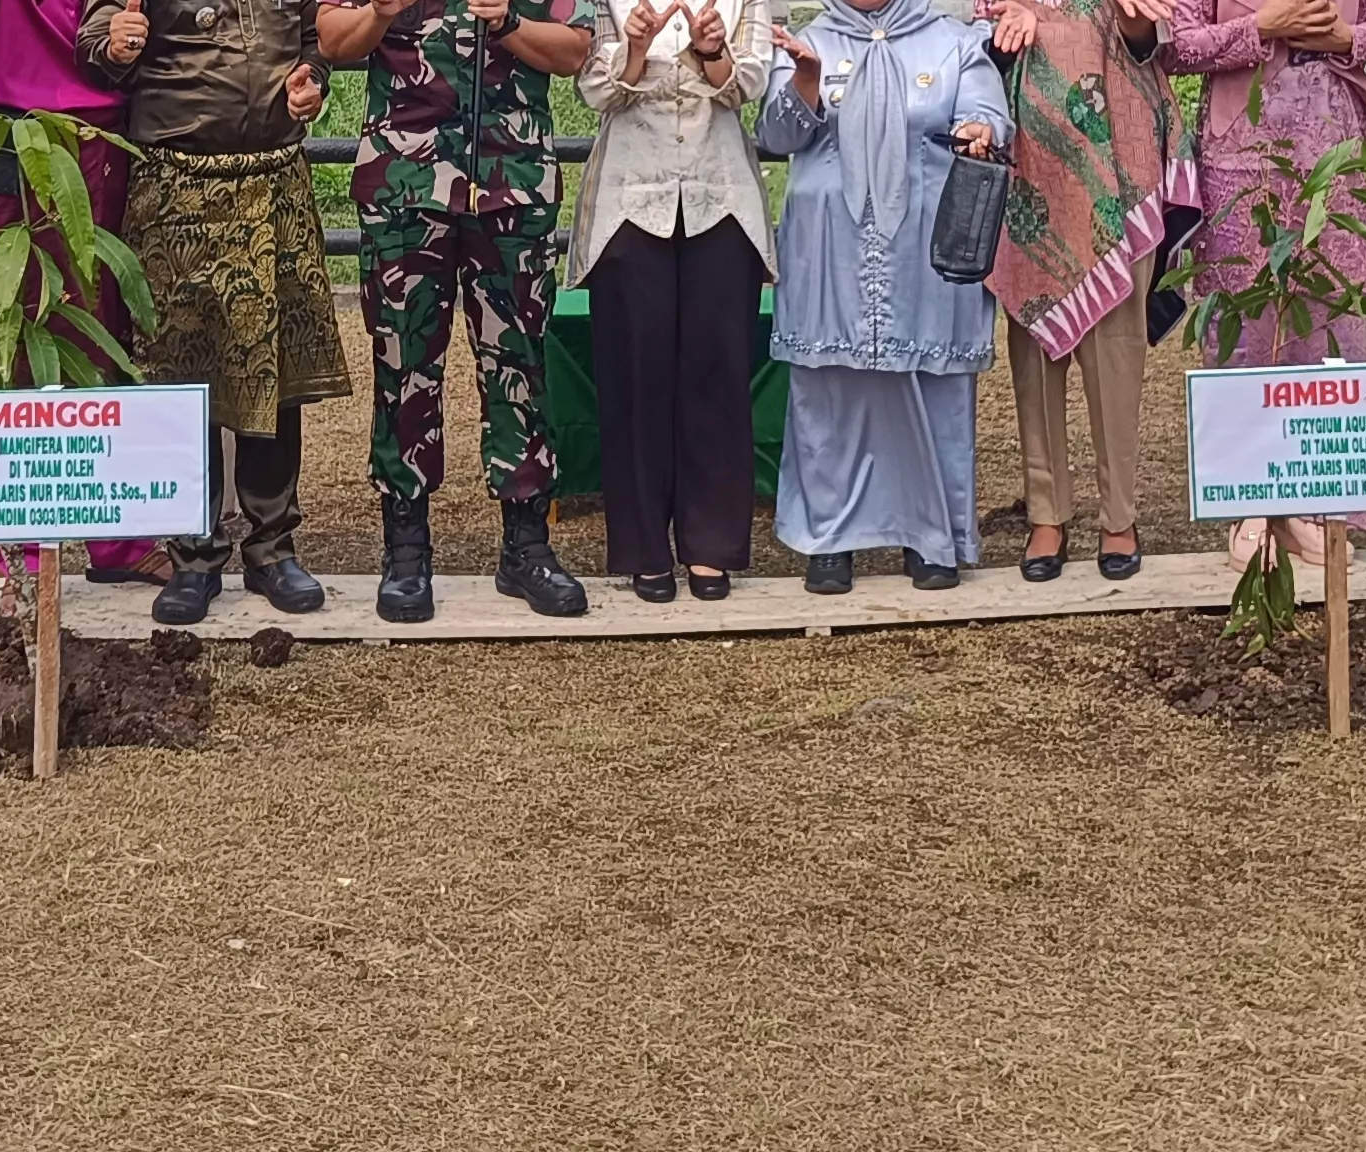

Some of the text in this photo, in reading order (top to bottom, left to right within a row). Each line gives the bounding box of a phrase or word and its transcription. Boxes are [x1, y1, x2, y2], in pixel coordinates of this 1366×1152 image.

[1261, 378, 1360, 408] JAMBU
[1289, 416, 1342, 435] SYZYGIUM
[0, 436, 62, 456] MANGIFERA
[66, 434, 105, 454] INDICA
[1300, 439, 1312, 456] DI
[1314, 437, 1349, 455] TANAM
[9, 459, 95, 478] DI TANAM OLEH
[1267, 461, 1284, 481] Ny.
[1285, 459, 1309, 477] VITA
[1311, 458, 1342, 476] HARIS
[1345, 457, 1366, 475] NUR
[29, 483, 53, 502] NUR
[56, 482, 108, 504] PRIATNO,
[150, 481, 178, 500] M.I.P
[1202, 484, 1236, 502] KETUA
[1238, 483, 1274, 501] PERSIT
[1276, 481, 1299, 499] KCK
[1300, 480, 1343, 498] CABANG
[1345, 479, 1359, 497] LII
[29, 505, 122, 528] 0303/BENGKALIS
